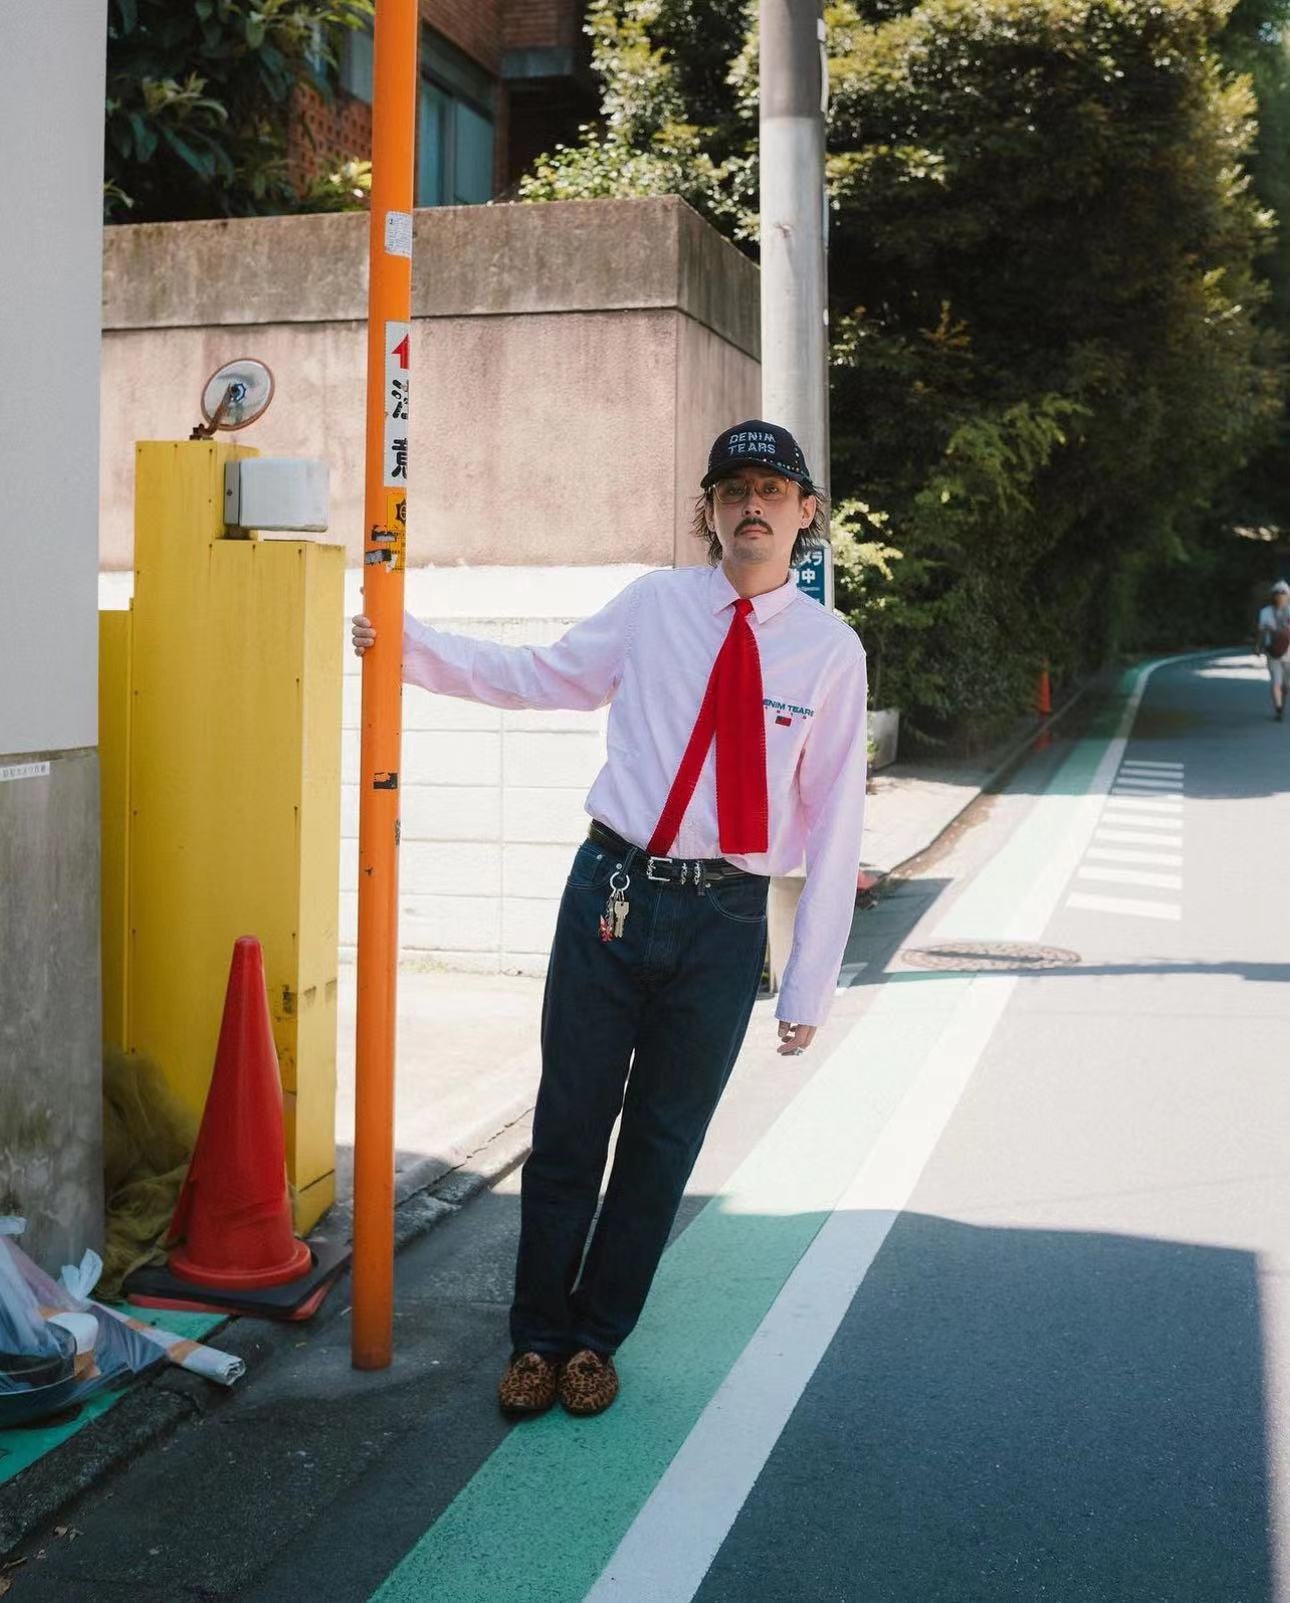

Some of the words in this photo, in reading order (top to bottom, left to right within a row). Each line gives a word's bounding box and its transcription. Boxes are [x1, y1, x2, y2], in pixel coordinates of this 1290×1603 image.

[729, 431, 776, 444] DENIM
[728, 442, 776, 456] TEARS
[763, 699, 785, 710] ENIM
